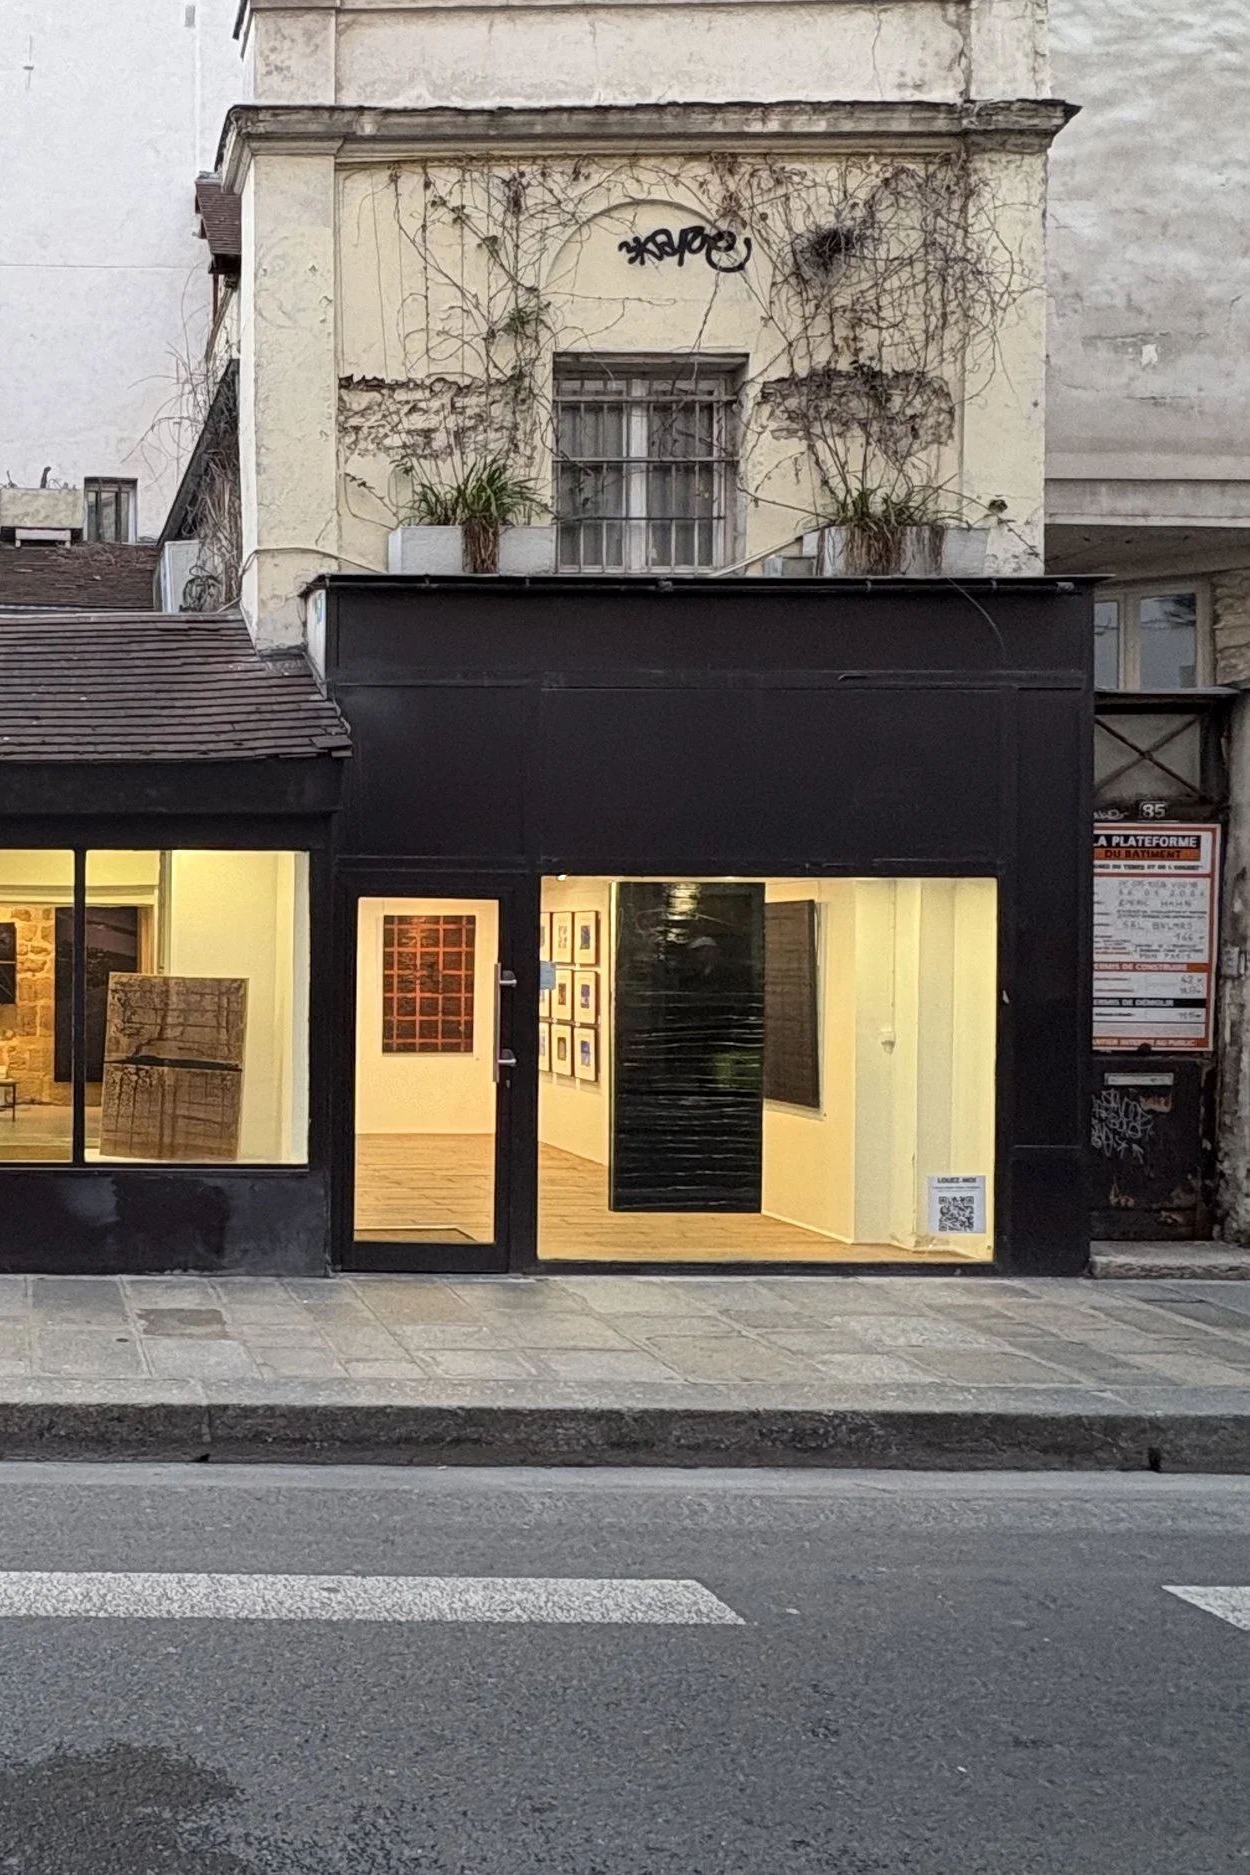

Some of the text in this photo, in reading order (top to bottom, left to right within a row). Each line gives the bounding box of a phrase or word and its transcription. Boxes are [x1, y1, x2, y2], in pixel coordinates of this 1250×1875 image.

[1142, 803, 1166, 818] 85
[1112, 836, 1197, 848] PLATEFORME
[1105, 850, 1121, 859] DU
